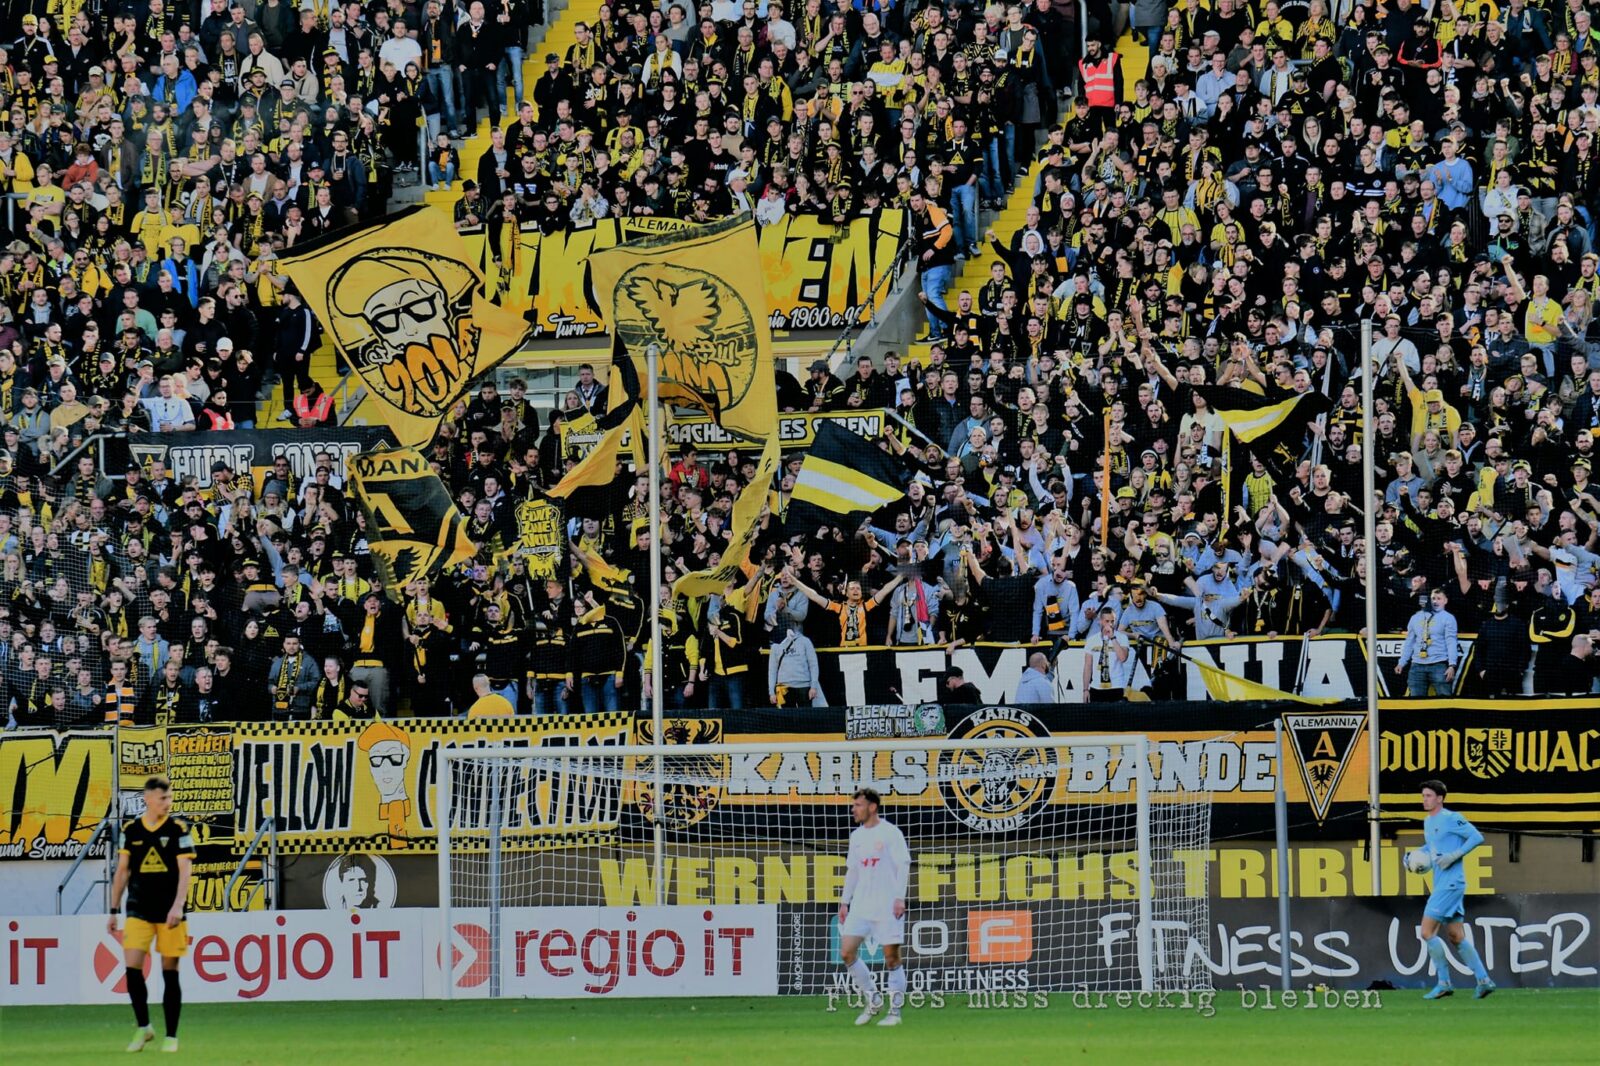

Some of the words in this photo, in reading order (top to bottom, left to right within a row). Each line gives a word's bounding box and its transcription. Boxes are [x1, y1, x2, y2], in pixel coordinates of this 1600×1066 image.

[970, 707, 1033, 727] KARLS
[1293, 718, 1358, 728] ALEMANNIA
[169, 734, 231, 755] FREIHEIT
[1379, 728, 1463, 772] DOM
[1470, 743, 1483, 756] 52
[170, 766, 231, 779] SICHERHEIT
[728, 750, 928, 795] KARLS
[1067, 741, 1277, 793] BANDE
[234, 741, 354, 832] YELLOW
[964, 812, 1027, 831] BANDE
[918, 850, 1154, 902] FUCHS
[8, 920, 58, 985] iT
[351, 914, 400, 978] iT
[515, 911, 685, 994] regio
[703, 910, 755, 976] iT
[912, 971, 938, 990] OF
[945, 969, 1029, 990] FITNESS
